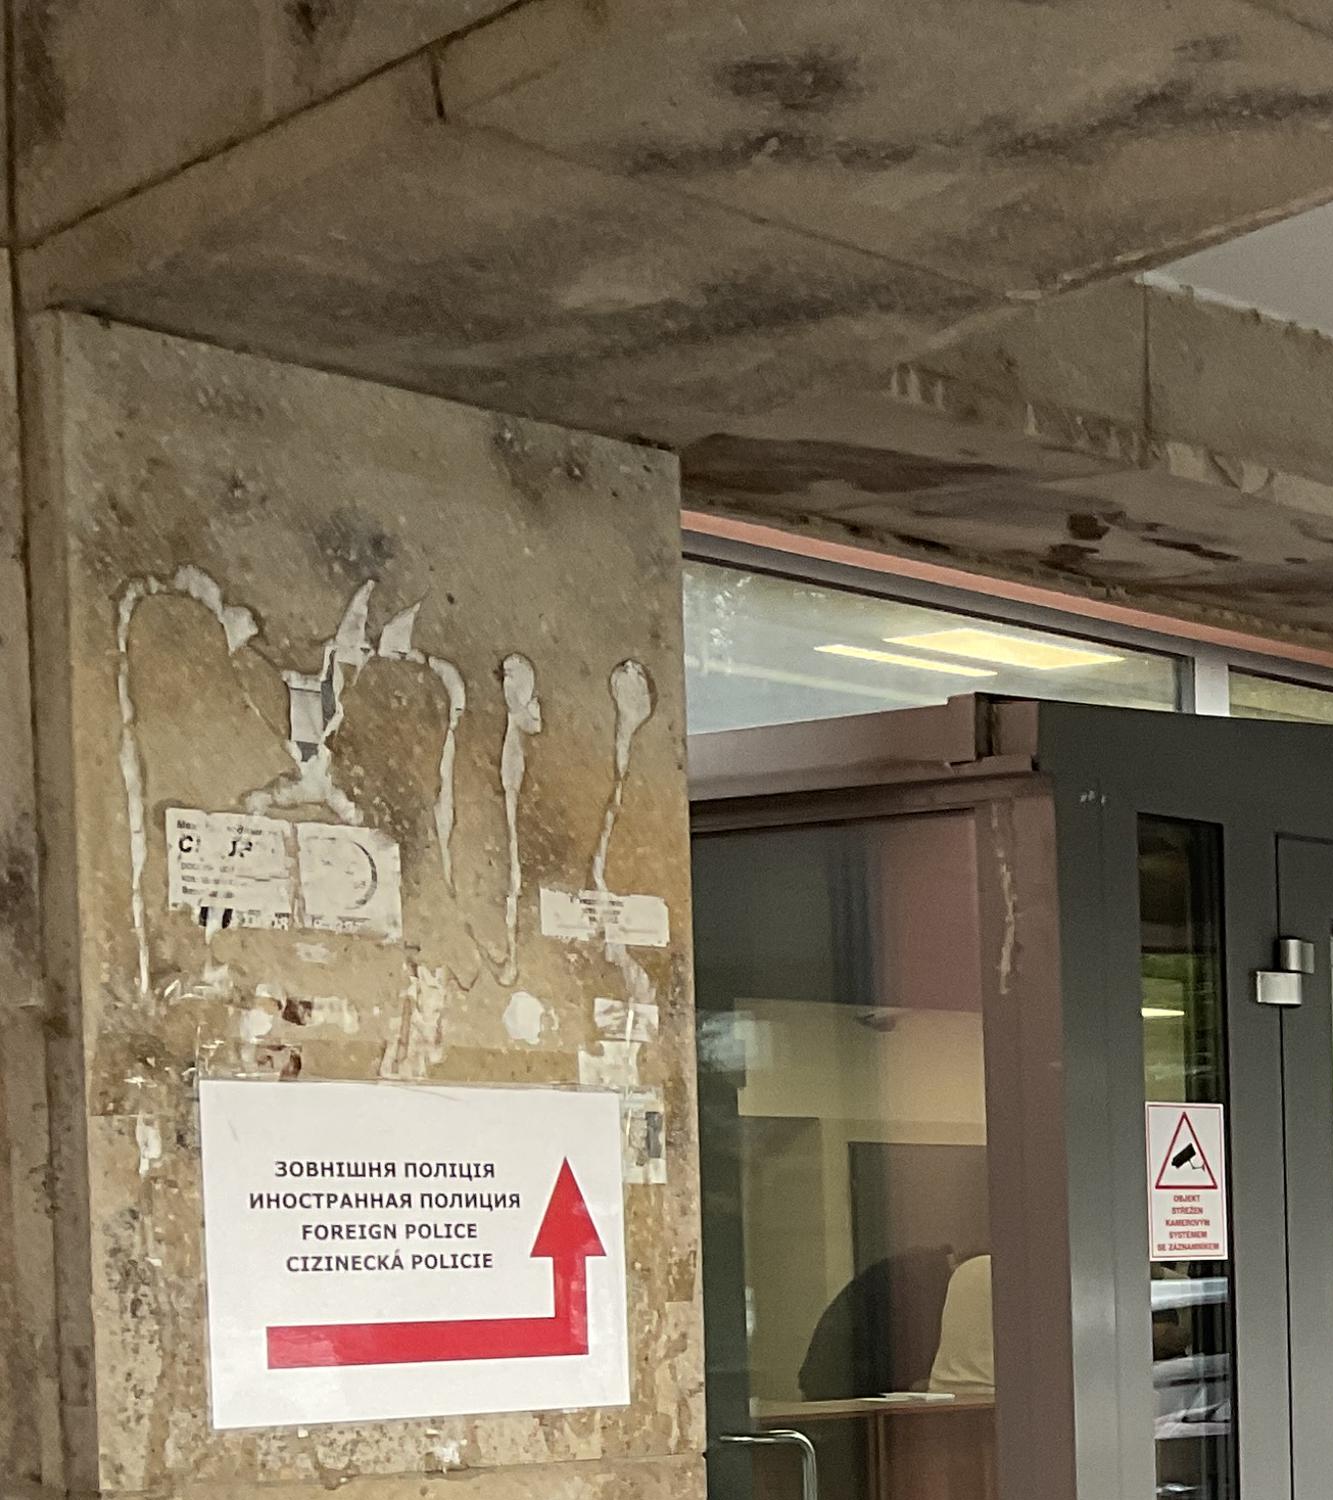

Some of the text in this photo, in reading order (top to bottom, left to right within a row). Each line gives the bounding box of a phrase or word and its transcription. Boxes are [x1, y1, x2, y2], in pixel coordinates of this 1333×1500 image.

[274, 1161, 495, 1182] ЗОВНІШНЯ ПОЛІЦІЯ
[249, 1193, 521, 1211] ИНОСТРАННАЯ ПОЛИЦИЯ
[302, 1223, 478, 1240] FOREIGN POLICE
[286, 1249, 493, 1272] CIZINECKÁ POLICIE
